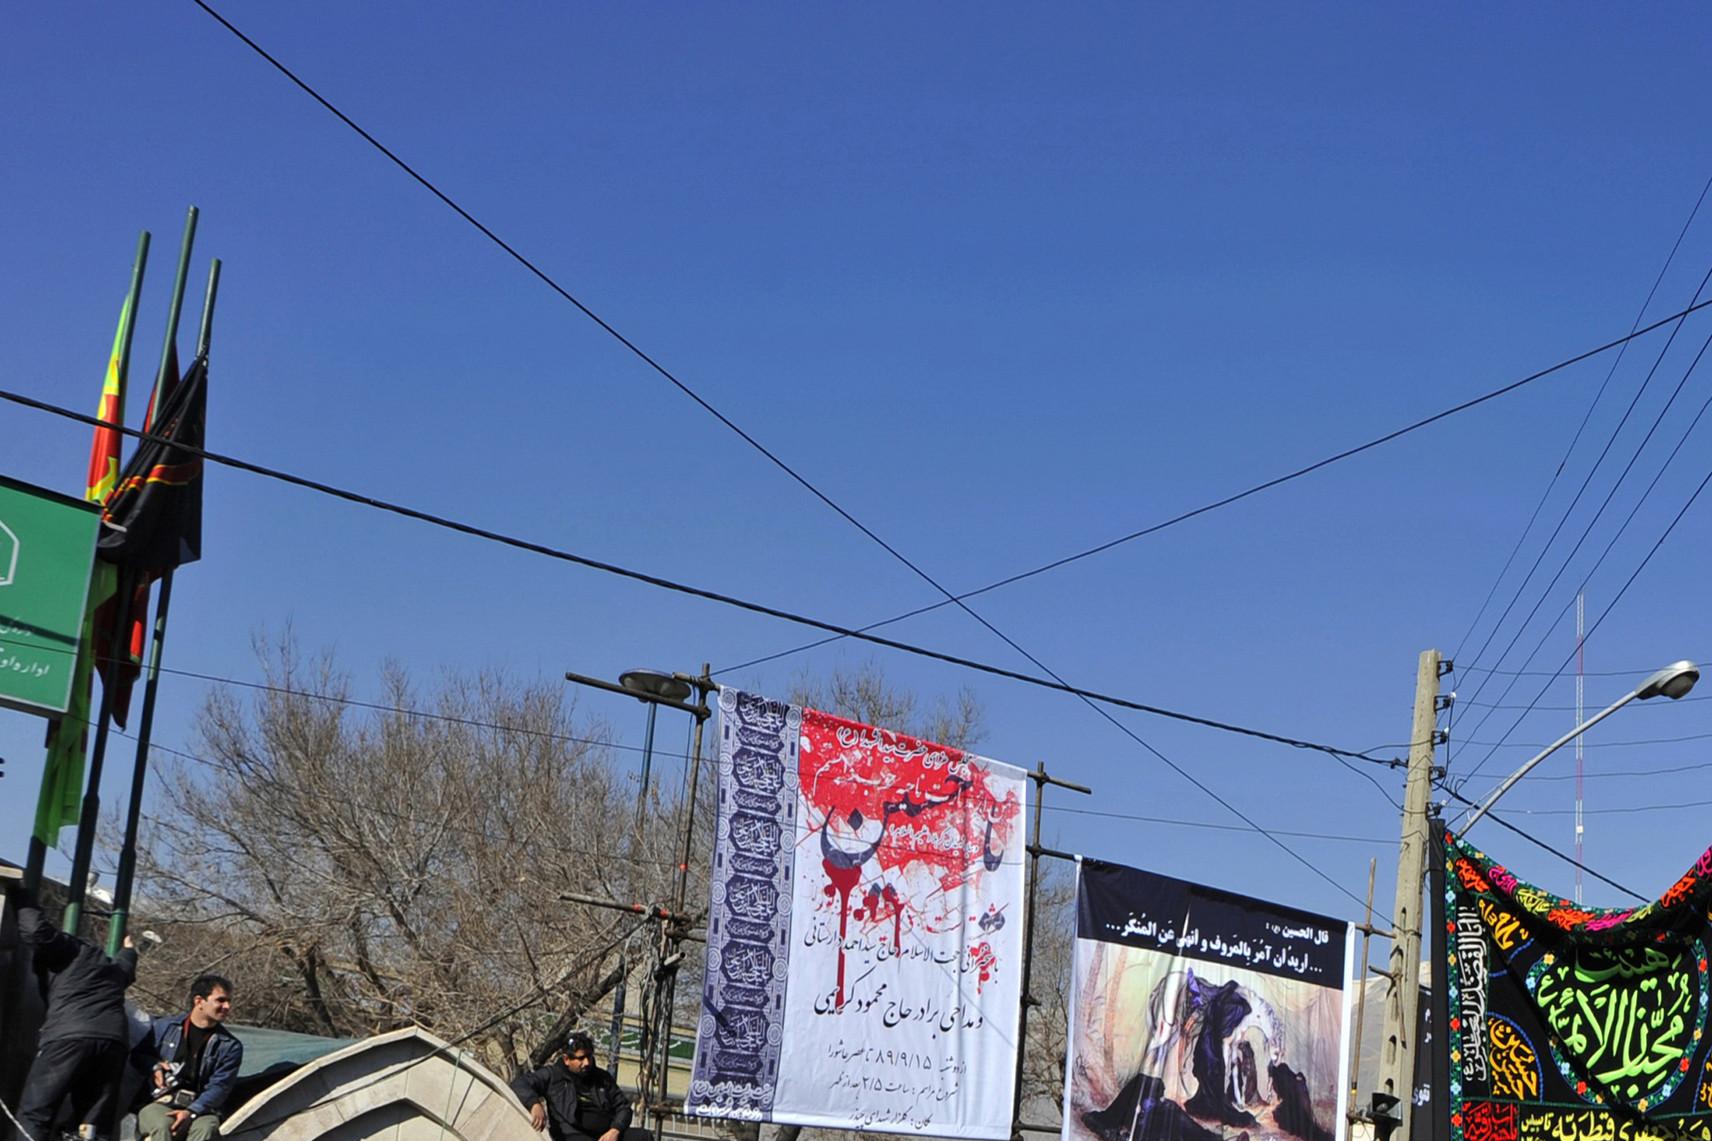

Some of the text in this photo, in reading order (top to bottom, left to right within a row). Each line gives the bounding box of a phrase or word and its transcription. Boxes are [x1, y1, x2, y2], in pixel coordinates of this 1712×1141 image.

[1282, 925, 1314, 940] الحسین
[1316, 930, 1329, 945] قال
[1200, 939, 1209, 953] و
[856, 983, 888, 1013] محمود
[883, 998, 913, 1028] حاج
[912, 997, 939, 1040] برادر
[875, 1049, 932, 1070] ۸۹/۹/۱۵
